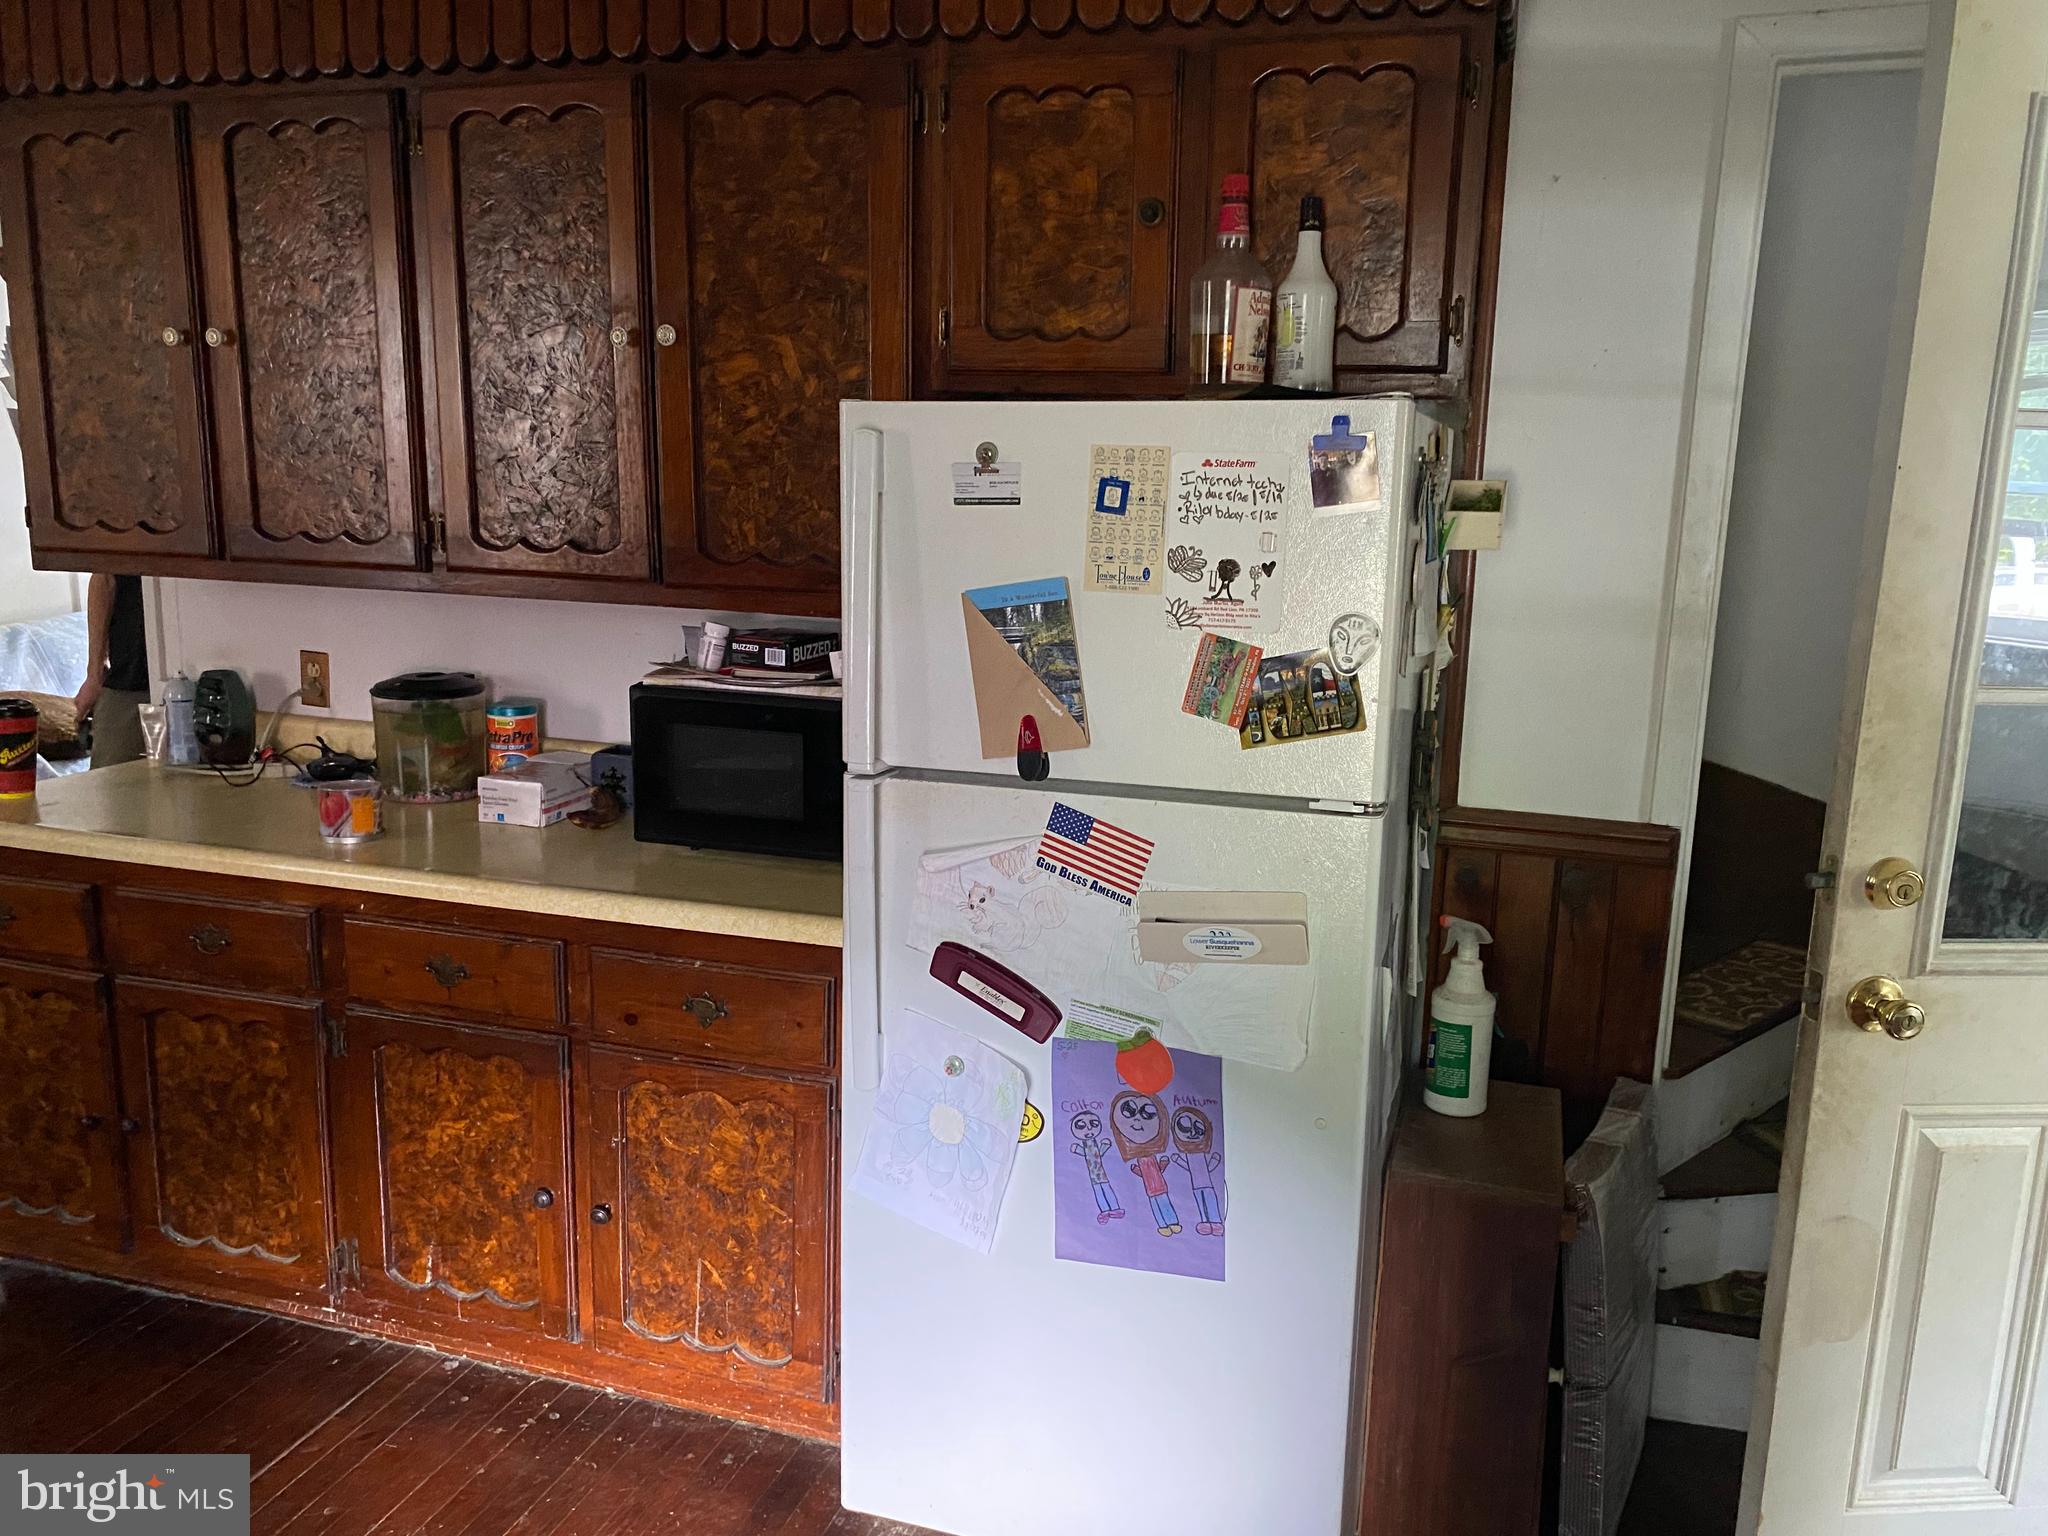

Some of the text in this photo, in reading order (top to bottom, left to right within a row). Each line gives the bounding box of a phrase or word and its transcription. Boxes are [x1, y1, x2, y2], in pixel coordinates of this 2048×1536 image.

[1181, 470, 1243, 487] Internet
[1205, 487, 1223, 500] due
[1216, 505, 1244, 523] bday
[732, 640, 831, 663] BUZZED BUZZED
[1036, 856, 1133, 907] GOD BLESS AMERICA
